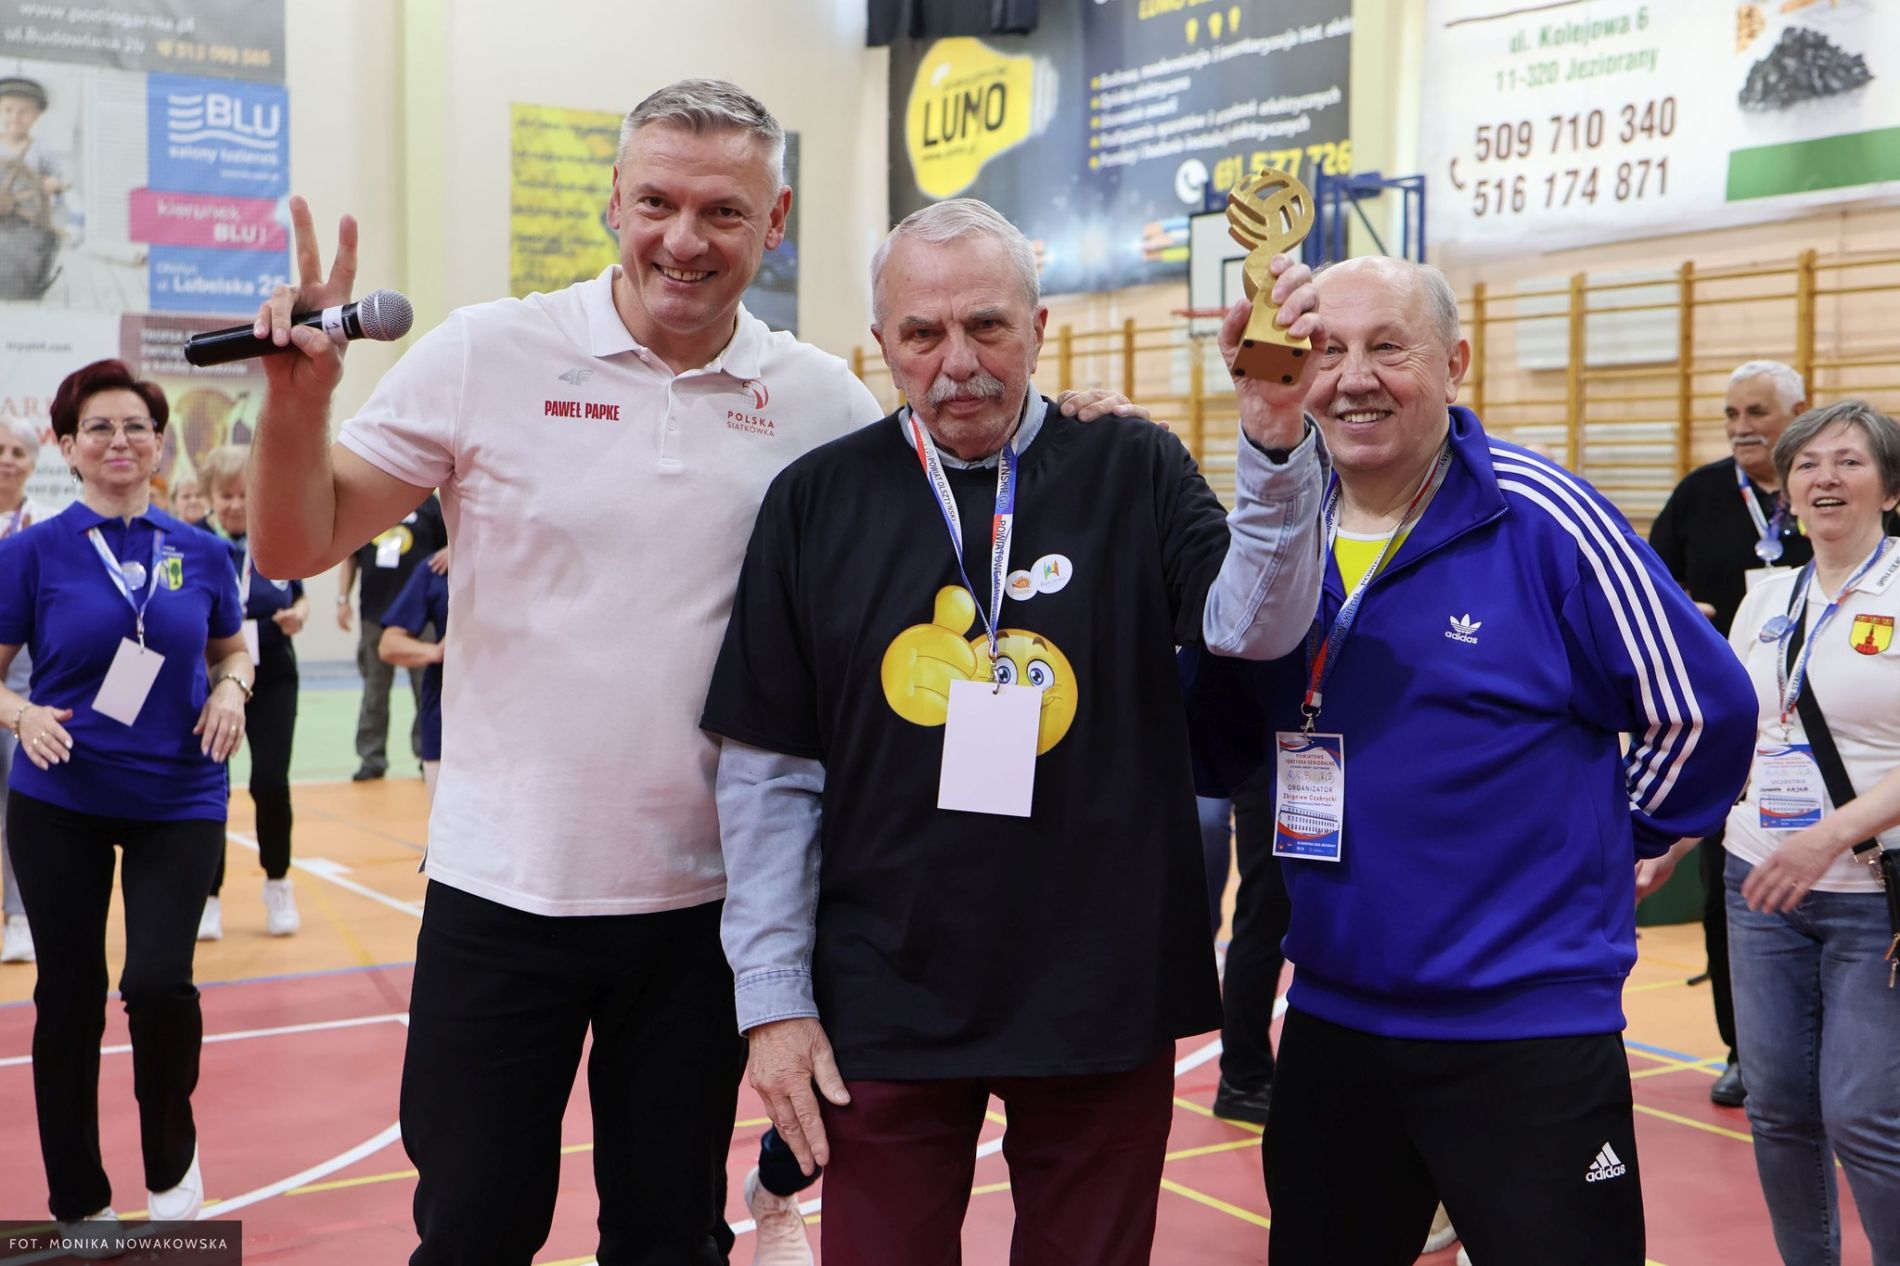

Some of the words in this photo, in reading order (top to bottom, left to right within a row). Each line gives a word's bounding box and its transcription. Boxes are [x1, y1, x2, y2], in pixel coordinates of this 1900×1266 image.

[1540, 15, 1631, 47] Kolejowa
[1637, 6, 1650, 31] 6
[1496, 60, 1560, 92] 11-320
[1566, 47, 1660, 82] Jeziorany
[205, 93, 280, 138] BLU
[923, 82, 1006, 148] LUMO
[1475, 120, 1534, 163] 509
[1550, 109, 1605, 155] 710
[1619, 97, 1677, 145] 340
[1473, 174, 1526, 217] 516
[1544, 167, 1598, 209] 174
[1615, 156, 1669, 202] 871
[544, 400, 582, 418] PAWEŁ
[584, 403, 620, 421] PAPKE
[727, 411, 775, 429] POLSKA
[727, 421, 775, 438] SIATKÓWKA
[994, 520, 1007, 576] POWIATOWE
[1444, 629, 1479, 645] adidas
[1283, 793, 1308, 801] Zbigniew
[1287, 784, 1333, 793] ORGANIZATOR
[1585, 1164, 1626, 1182] adidas
